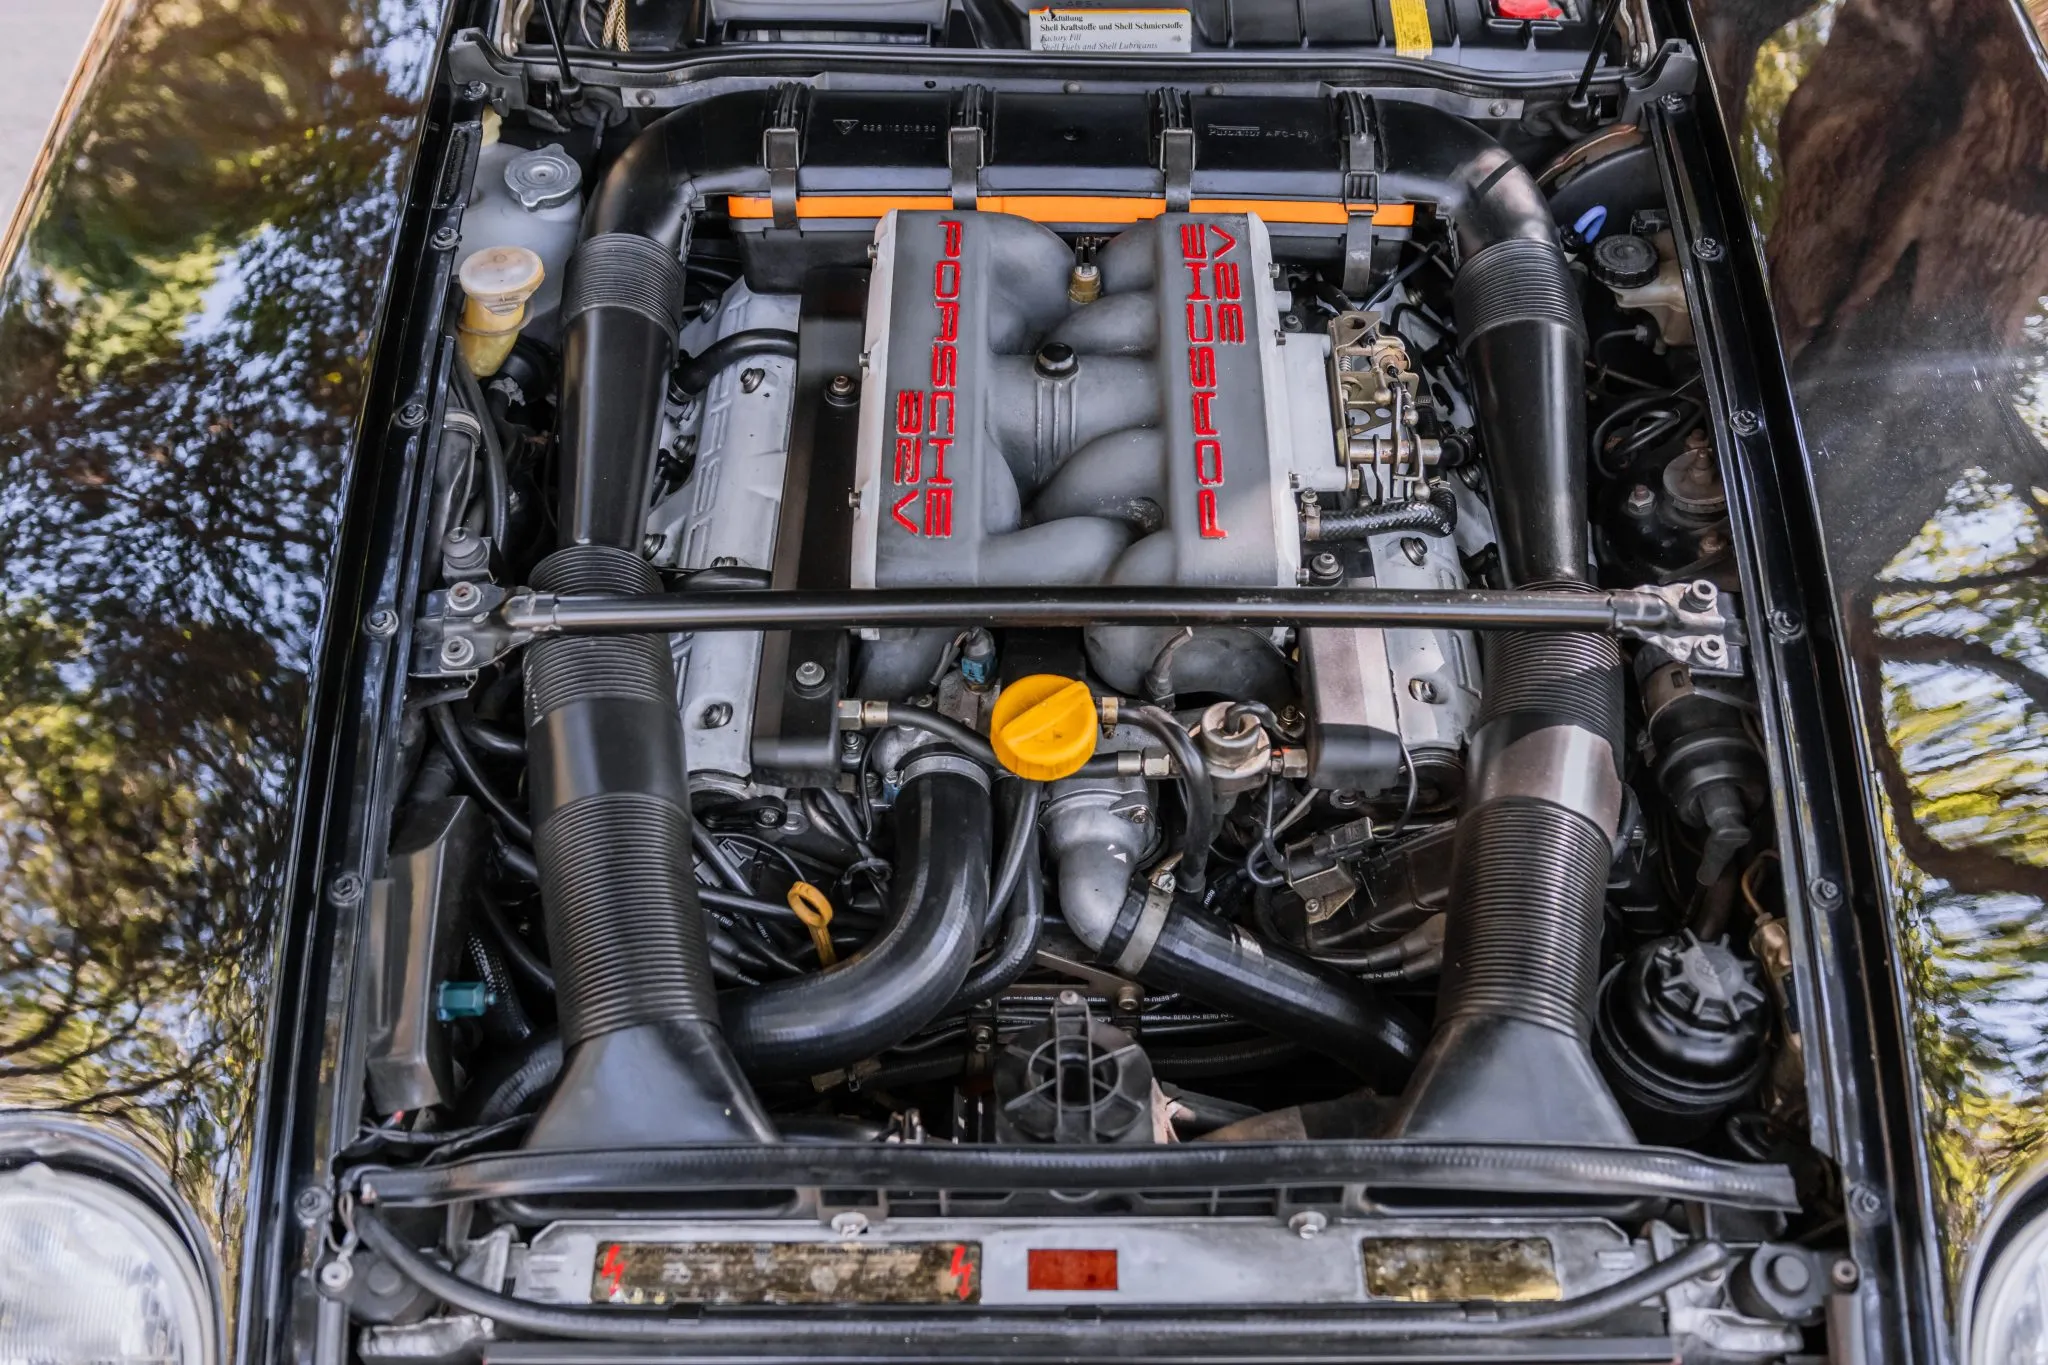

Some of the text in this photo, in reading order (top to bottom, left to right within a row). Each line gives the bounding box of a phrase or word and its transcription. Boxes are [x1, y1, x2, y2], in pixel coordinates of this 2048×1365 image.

[1041, 43, 1060, 51] Shell
[1099, 42, 1117, 50] Shell
[1119, 42, 1158, 50] Lubricants
[1061, 23, 1096, 31] Kraftstoffe
[1115, 22, 1133, 30] Shell
[1135, 22, 1183, 30] Schmierstoffe
[1209, 224, 1246, 345] 32V
[924, 219, 964, 538] PORSCHE
[1180, 223, 1229, 539] PORSCHE
[891, 389, 924, 536] 32V
